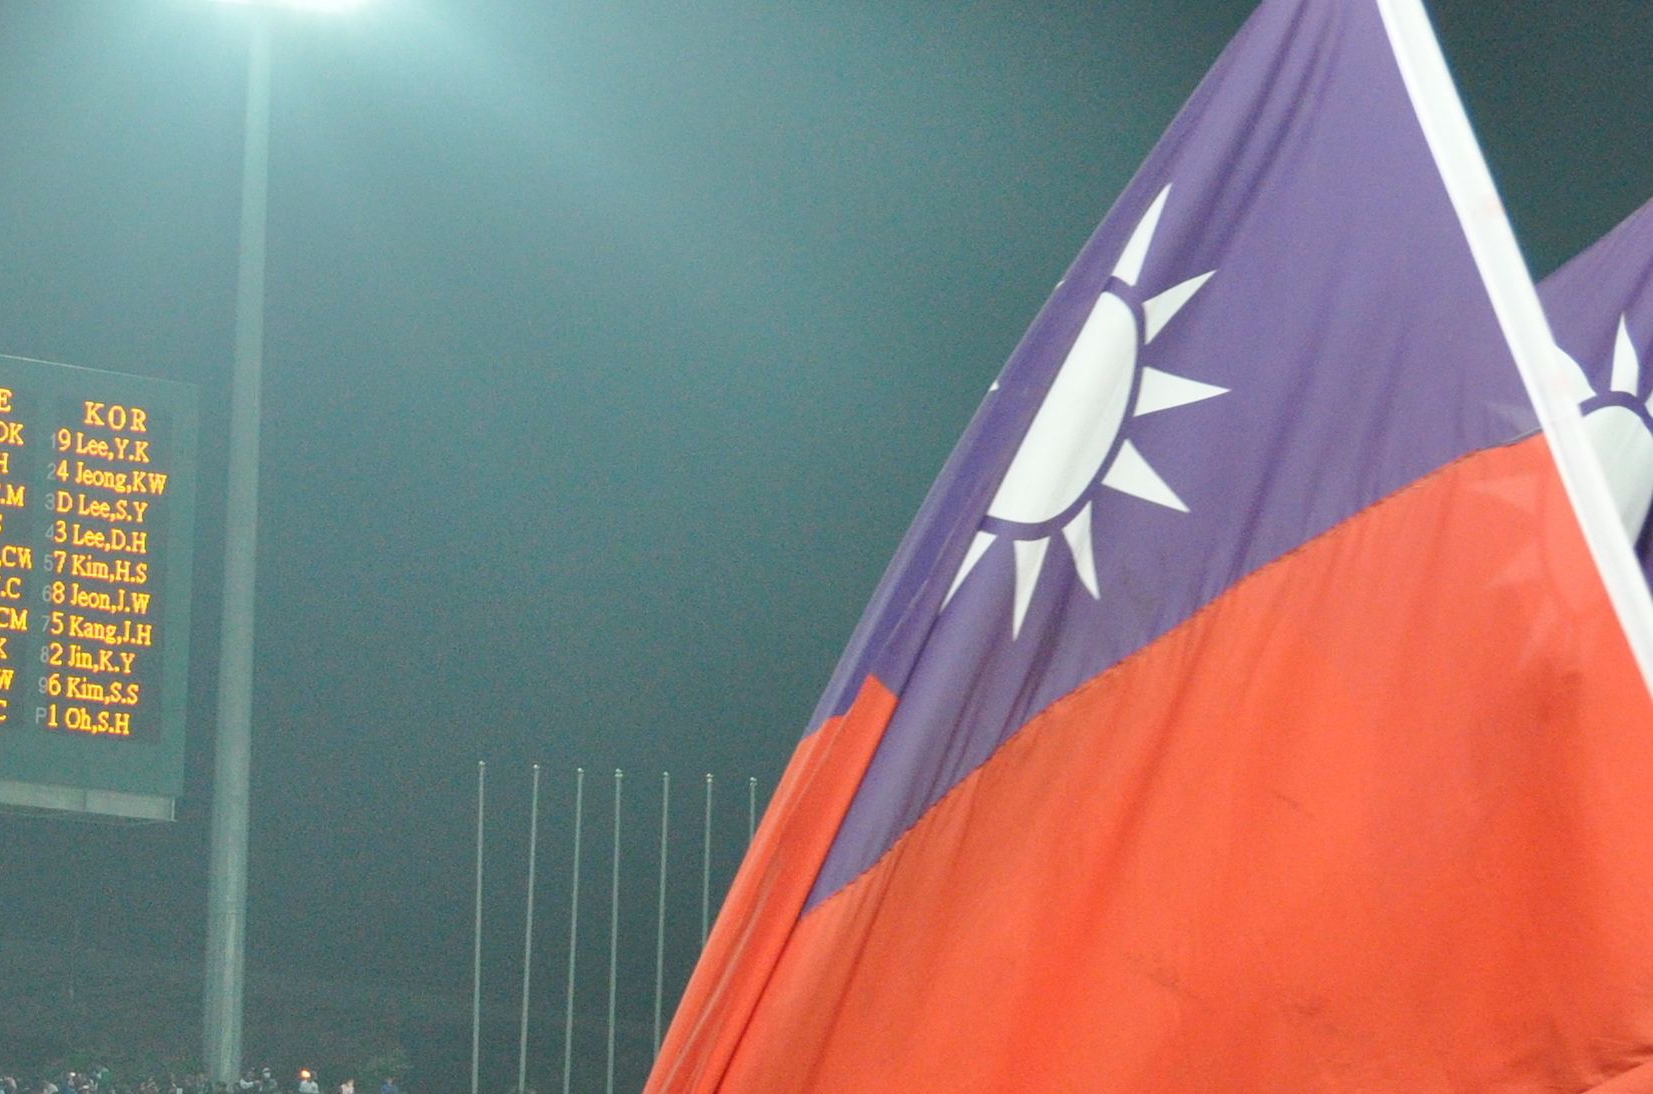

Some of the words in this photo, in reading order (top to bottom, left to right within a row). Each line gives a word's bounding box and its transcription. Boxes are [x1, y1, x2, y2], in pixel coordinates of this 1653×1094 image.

[84, 401, 147, 432] KOR
[57, 428, 72, 451] 9
[76, 432, 150, 463] Lee,Y.K
[57, 459, 69, 482] 4
[75, 461, 167, 495] Jeong,KW
[56, 490, 73, 513] D
[78, 493, 148, 522] Lee,S.Y
[54, 520, 68, 543] 3
[72, 524, 147, 553] Lee,D.H
[54, 550, 66, 574] 7
[71, 554, 148, 584] Kim,H.S
[52, 581, 65, 604] 8
[70, 583, 151, 614] Jeon,J.W
[50, 611, 64, 635] 5
[69, 615, 152, 646] Kang,J.H
[49, 642, 63, 666] 2
[68, 644, 136, 673] Jin,K.Y
[48, 673, 62, 696] 6
[66, 676, 140, 705] Kim,S.S
[48, 704, 58, 727] 1
[65, 707, 131, 735] Oh,S.H
